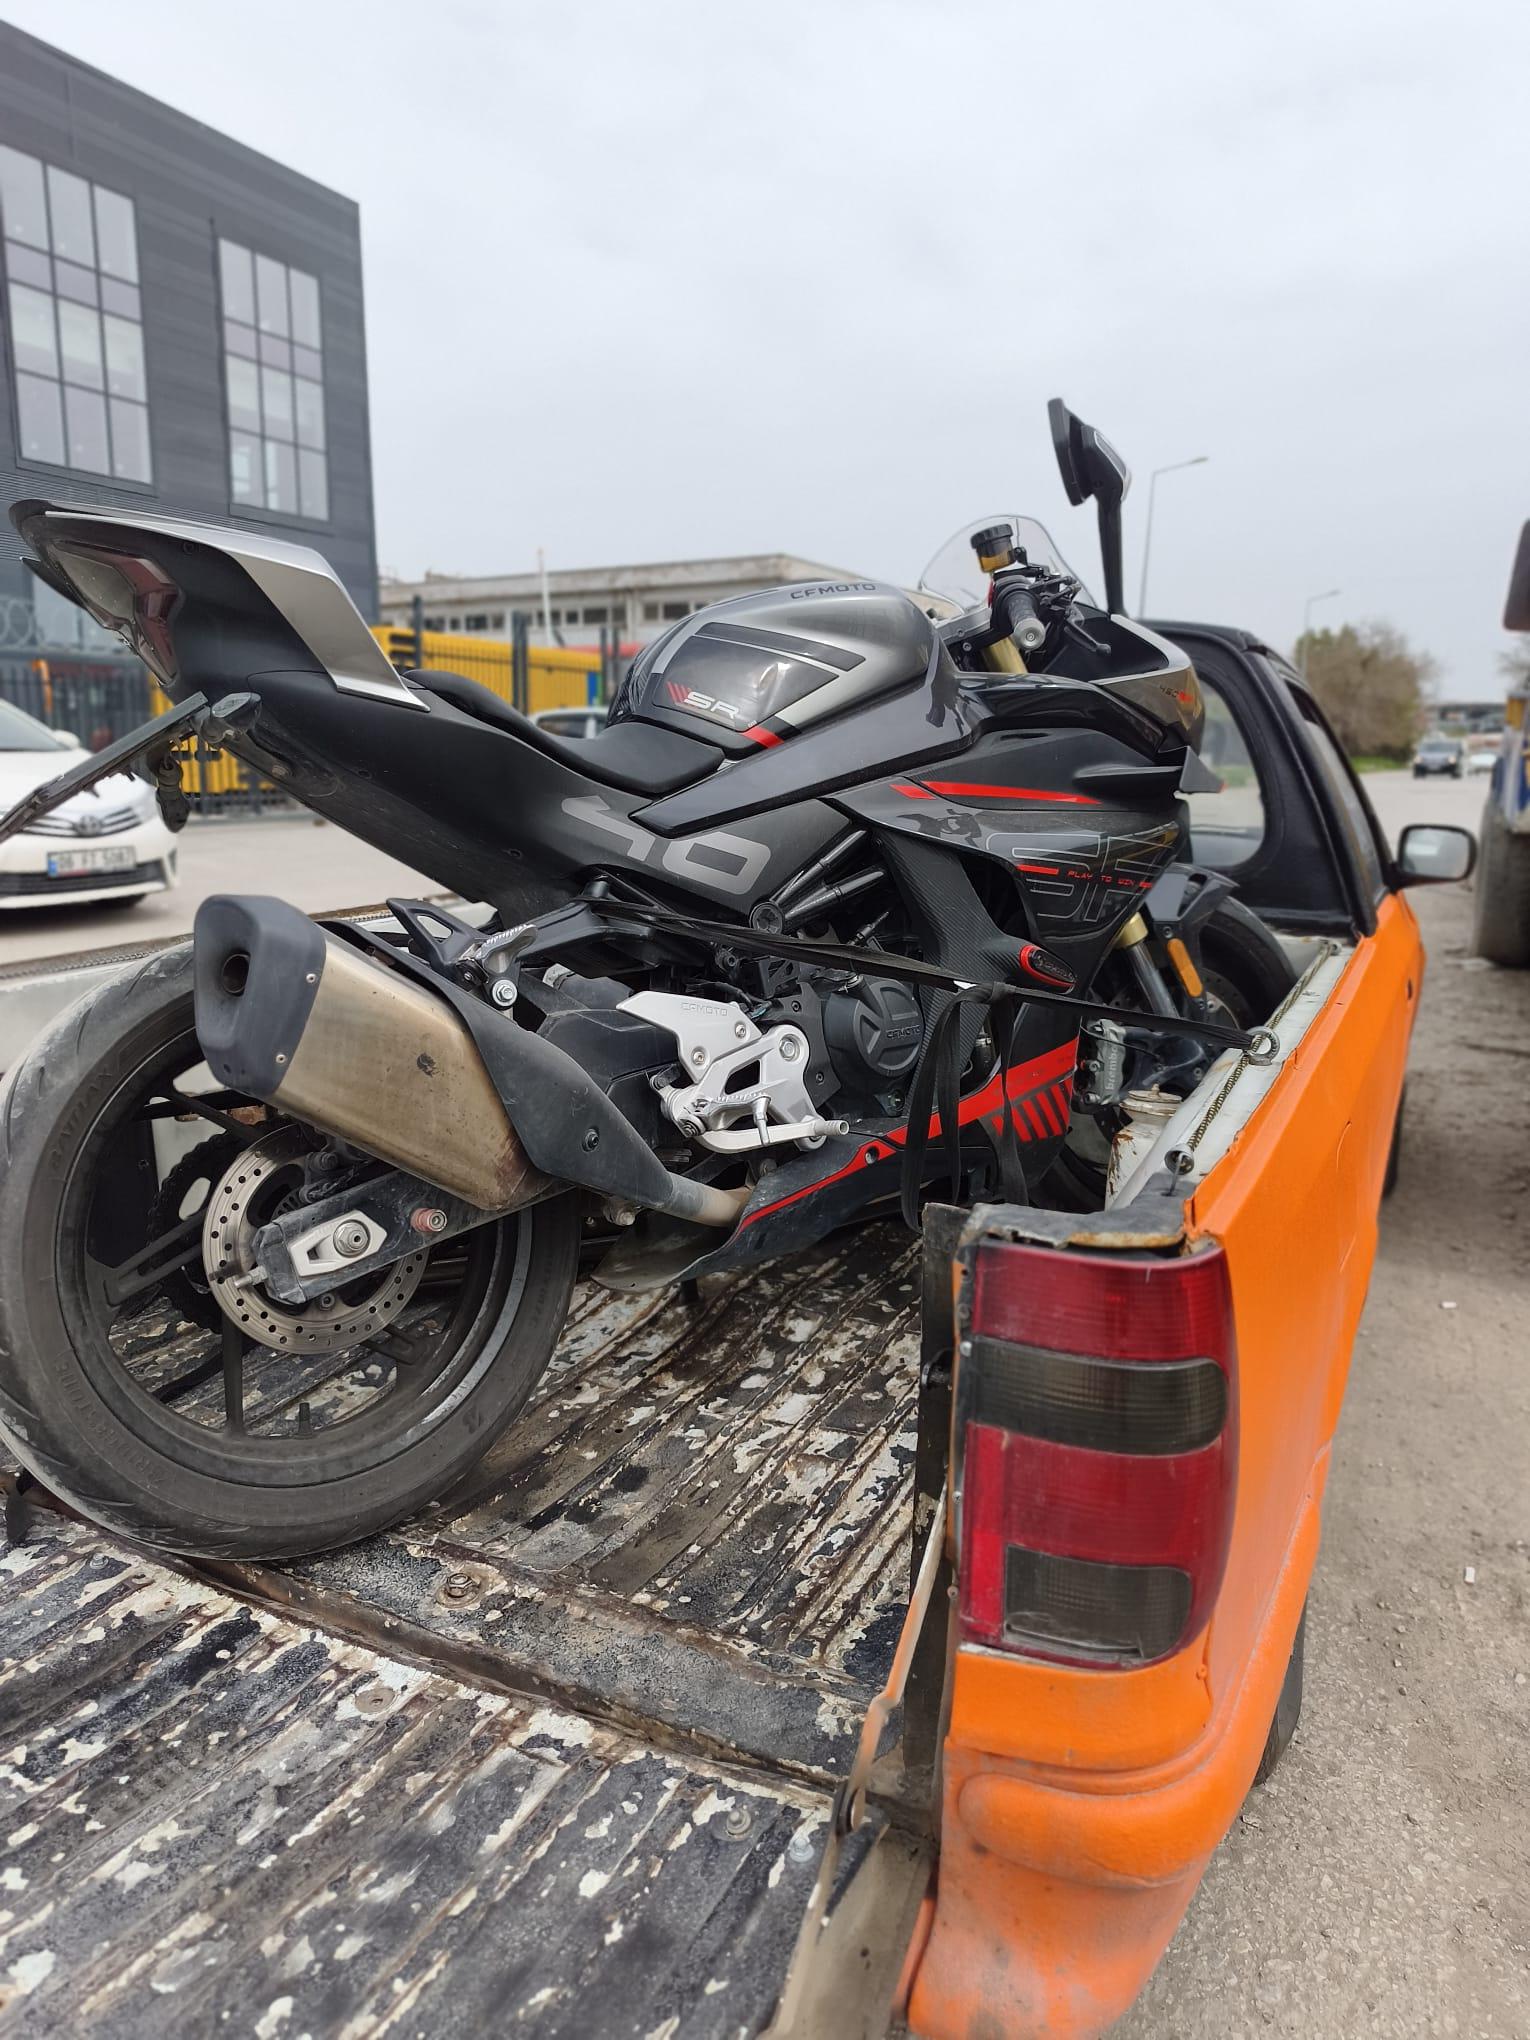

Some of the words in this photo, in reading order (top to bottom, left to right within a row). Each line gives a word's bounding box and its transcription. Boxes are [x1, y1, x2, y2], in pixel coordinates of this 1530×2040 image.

[790, 582, 876, 599] CFMOTO
[683, 691, 739, 719] SR
[1067, 870, 1093, 880] PLAY
[1100, 875, 1112, 883] TO
[681, 1002, 728, 1017] CFMOTO
[1105, 1046, 1119, 1091] brembo
